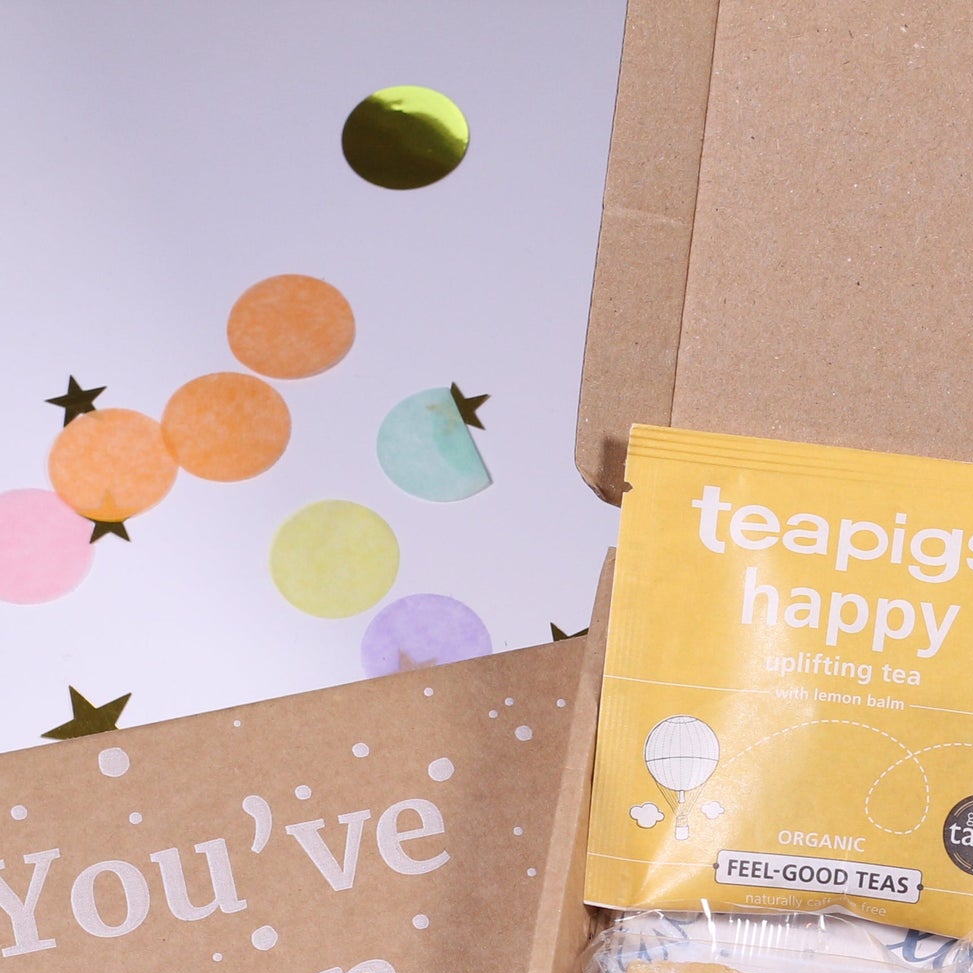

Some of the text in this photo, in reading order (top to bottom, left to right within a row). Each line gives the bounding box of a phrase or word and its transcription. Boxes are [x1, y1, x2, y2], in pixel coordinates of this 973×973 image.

[741, 567, 961, 658] happy
[765, 653, 921, 686] uplifting tea
[775, 687, 905, 710] with lemon balm
[777, 830, 865, 853] ORGANIC
[726, 857, 909, 895] FEEL-GOOD TEAS
[745, 892, 802, 907] naturally
[860, 901, 887, 916] free
